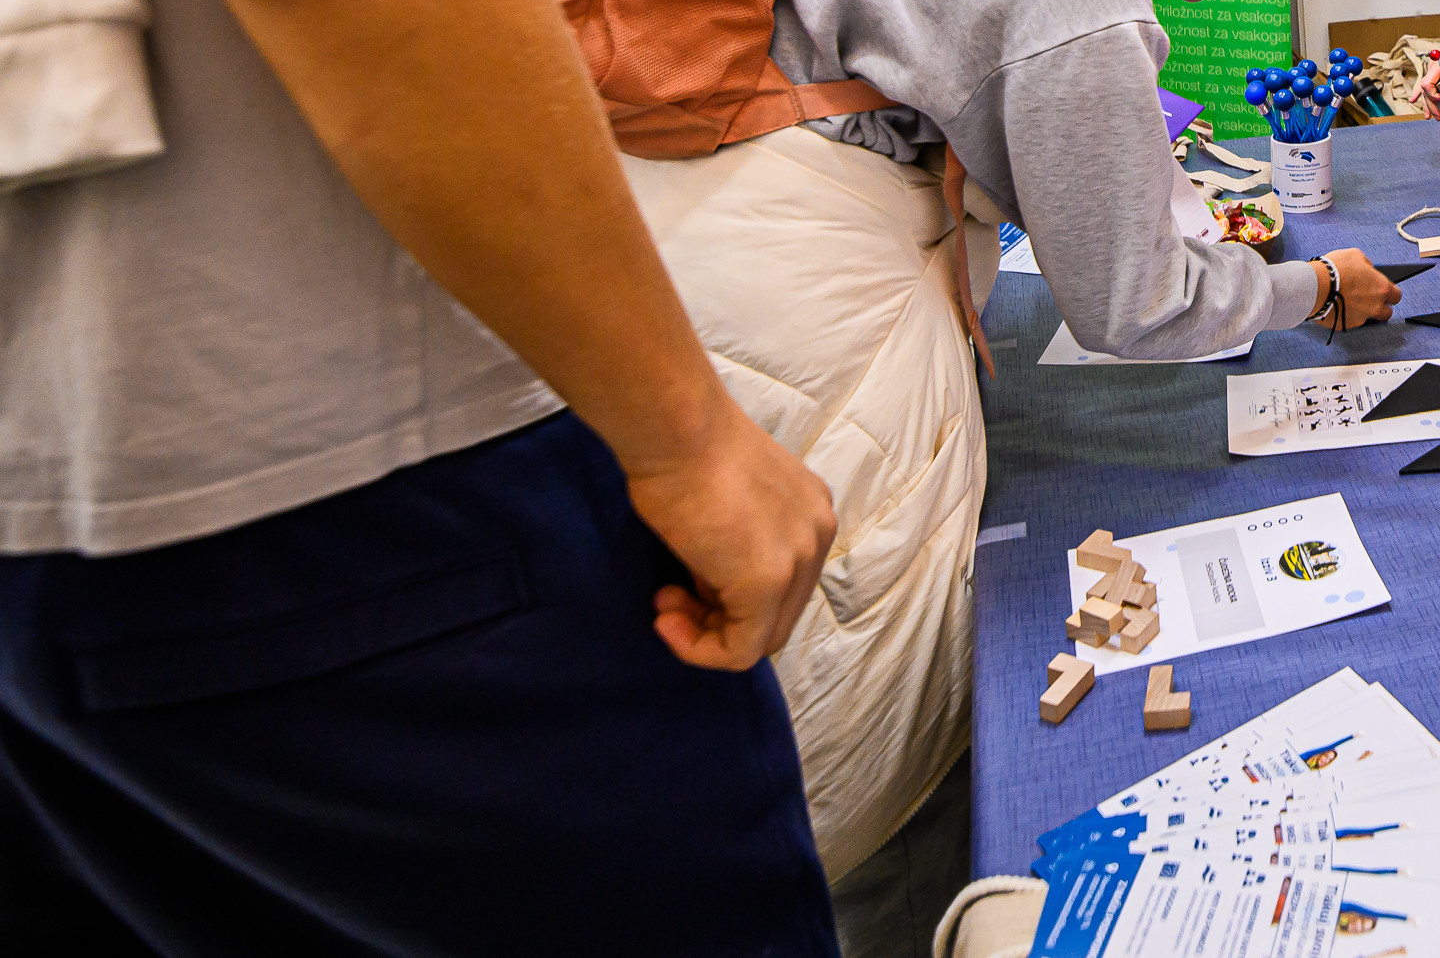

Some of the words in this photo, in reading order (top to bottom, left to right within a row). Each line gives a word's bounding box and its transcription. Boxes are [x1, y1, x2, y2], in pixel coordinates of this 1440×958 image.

[1155, 3, 1213, 21] Priložnost
[1217, 10, 1232, 22] za
[1235, 8, 1290, 27] vsakoga
[1214, 27, 1229, 39] za
[1168, 43, 1207, 57] ožnost
[1211, 46, 1226, 58] za
[1228, 45, 1287, 64] vsakogar
[1207, 64, 1223, 76] za
[1204, 83, 1220, 94] za
